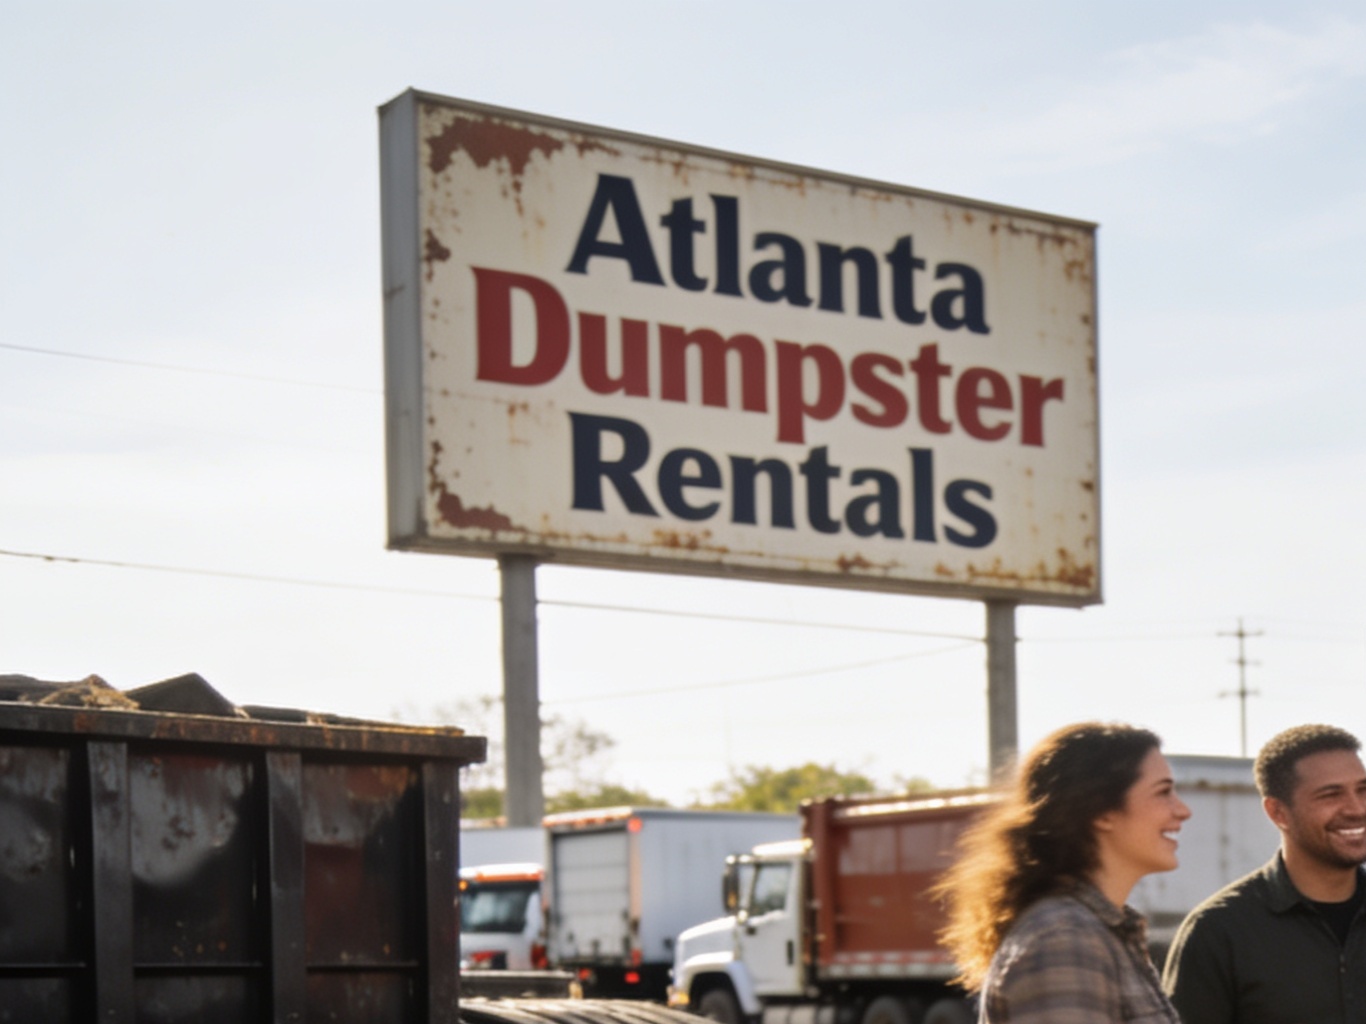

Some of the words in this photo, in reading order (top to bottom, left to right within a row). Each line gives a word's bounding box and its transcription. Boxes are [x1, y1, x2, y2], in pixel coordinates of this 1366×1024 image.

[565, 172, 991, 336] Atlanta
[471, 266, 1065, 448] Dumpster
[567, 411, 998, 549] Rentals
